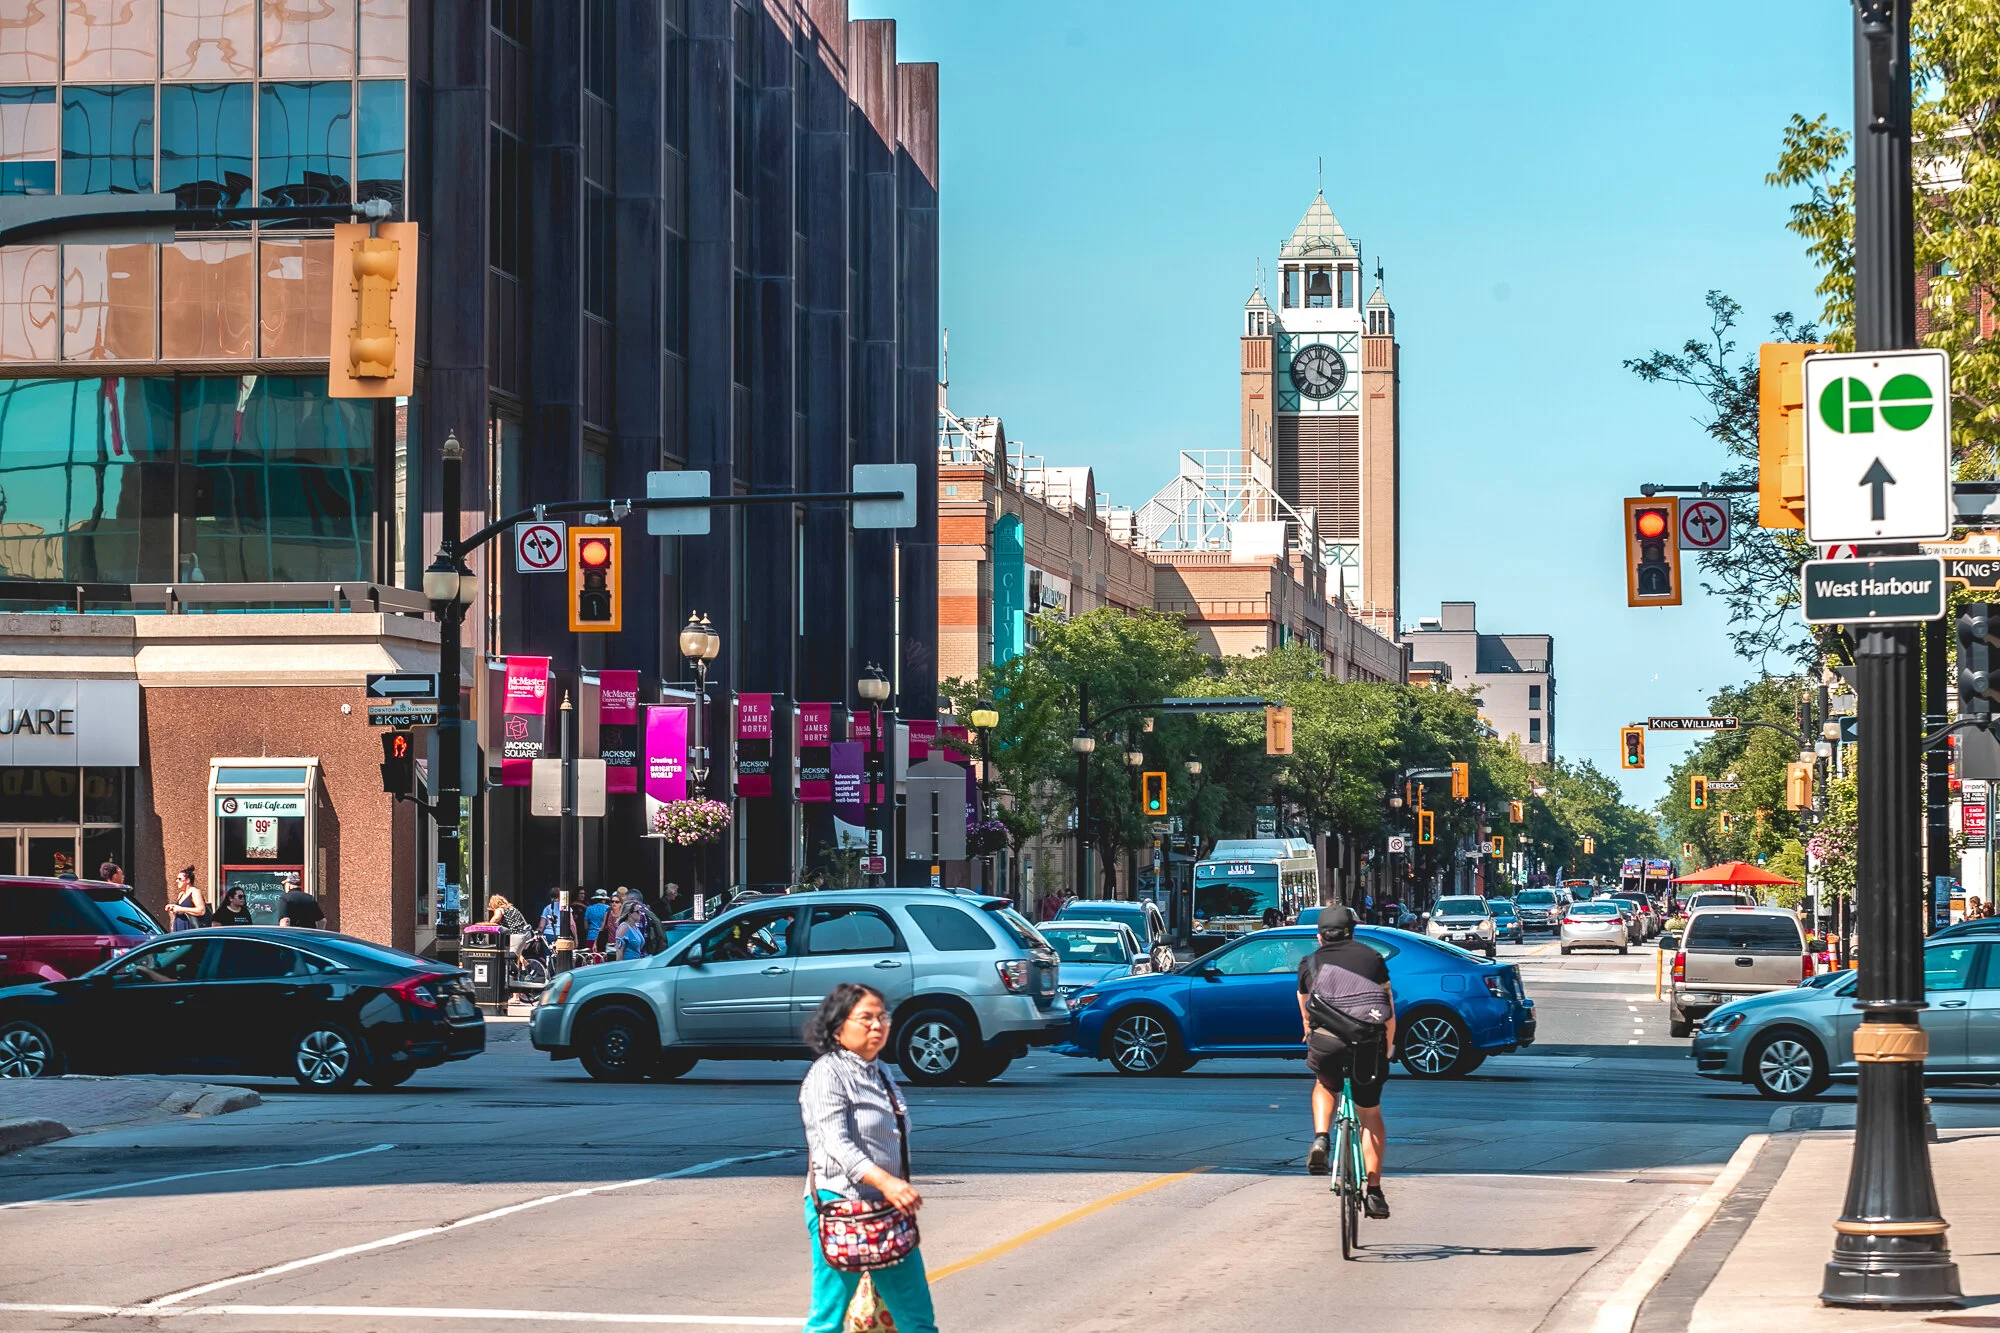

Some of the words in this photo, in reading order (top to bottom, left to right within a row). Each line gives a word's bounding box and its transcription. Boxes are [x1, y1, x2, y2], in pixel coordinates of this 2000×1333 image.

[1818, 373, 1933, 434] GO
[1952, 561, 1990, 577] KING
[1815, 580, 1858, 598] West
[1861, 577, 1932, 596] Harbour
[1002, 572, 1014, 637] CITY
[508, 676, 546, 686] McMaster
[602, 689, 636, 698] McMaster
[742, 705, 757, 713] ONE
[384, 715, 409, 725] KING
[420, 714, 432, 724] W
[1652, 719, 1678, 728] KING
[1681, 719, 1724, 728] WILLIAM
[742, 725, 767, 733] NORTH
[504, 742, 543, 750] JACKSON
[504, 749, 538, 758] SQUARE
[601, 750, 636, 758] JACKSON
[244, 801, 297, 811] Venti-Cafe.com
[1209, 865, 1216, 876] 7
